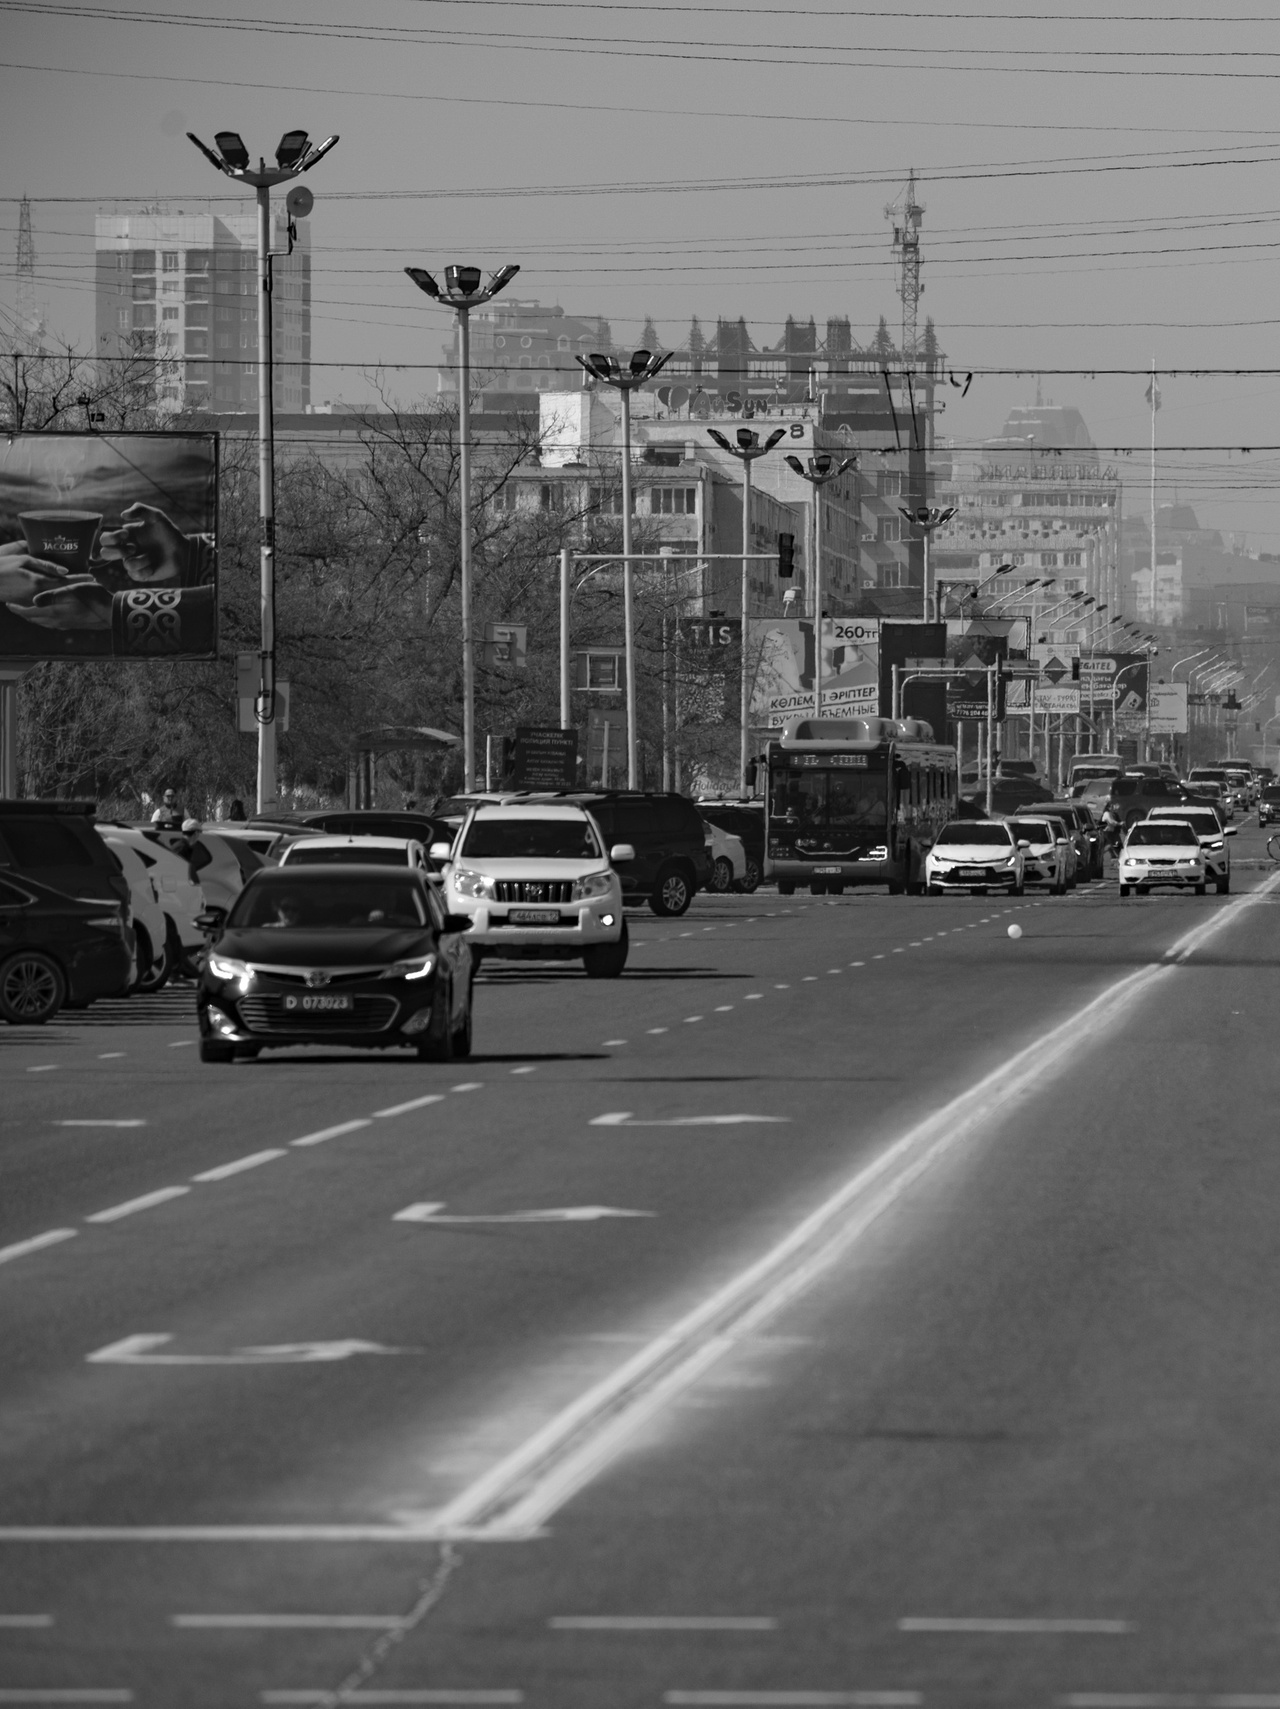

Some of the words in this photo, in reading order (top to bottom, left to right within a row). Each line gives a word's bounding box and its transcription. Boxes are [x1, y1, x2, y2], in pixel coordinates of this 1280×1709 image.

[43, 542, 79, 551] JACOBS
[829, 686, 876, 701] ӘРІПТЕР
[286, 995, 298, 1009] D
